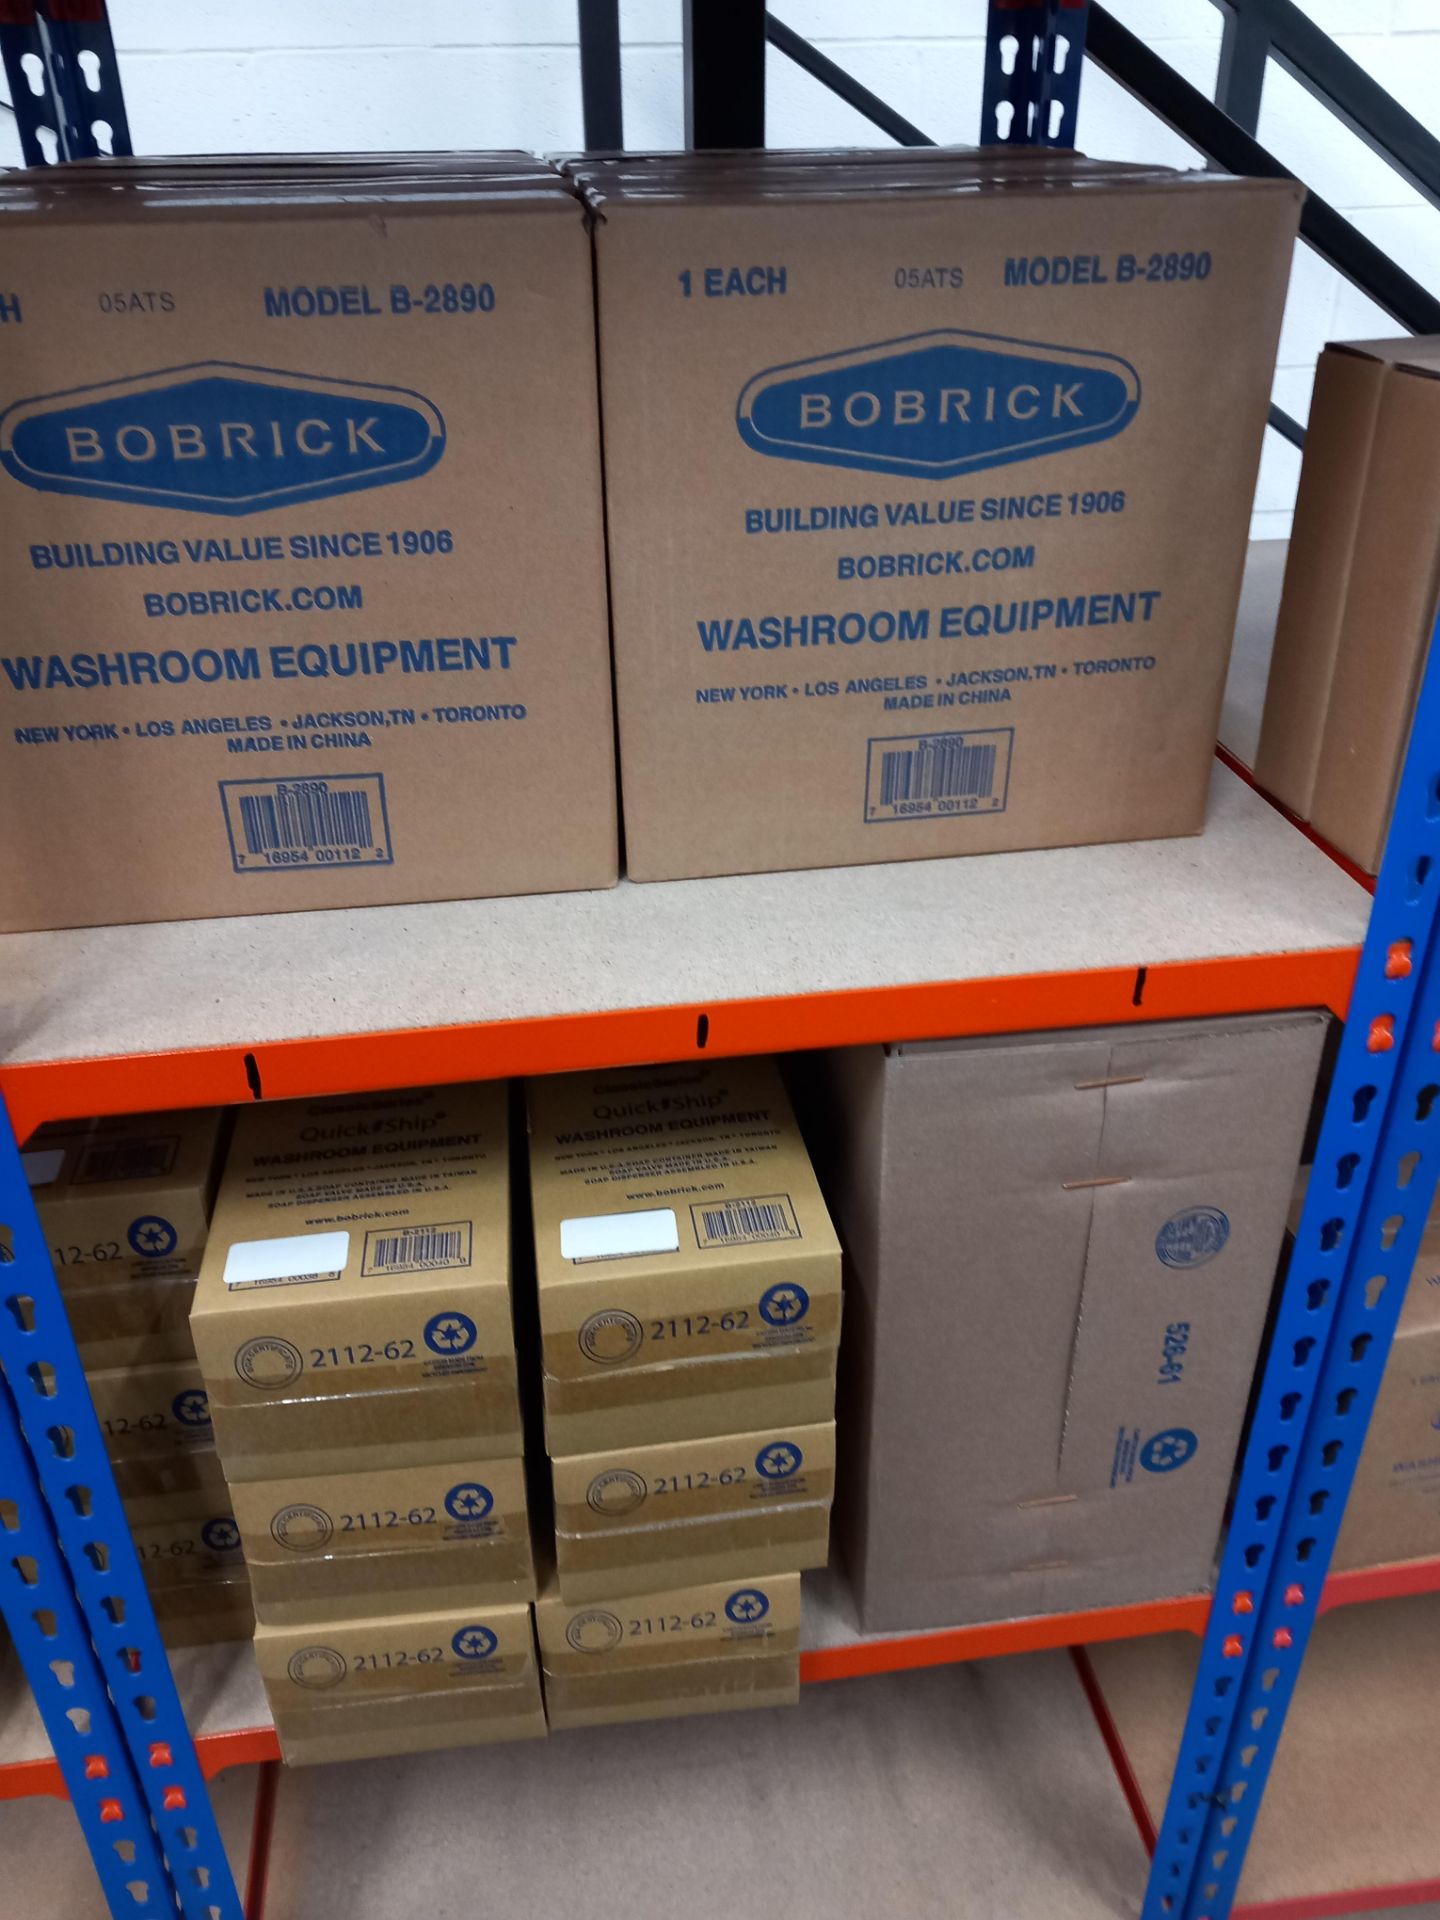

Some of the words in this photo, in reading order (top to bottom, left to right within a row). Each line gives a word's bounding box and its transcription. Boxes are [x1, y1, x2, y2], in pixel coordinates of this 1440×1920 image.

[678, 270, 691, 297] 1
[704, 266, 787, 296] EACH
[1003, 256, 1107, 287] MODEL
[1115, 252, 1211, 283] B-2890
[264, 285, 382, 318] MODEL
[390, 283, 495, 314] B-2890
[800, 382, 1084, 429] BOBRICK
[66, 417, 385, 463] BOBRICK
[745, 505, 879, 534] BUILDING
[884, 500, 974, 526] VALUE
[980, 494, 1062, 521] SINCE
[1066, 491, 1126, 515] 1906
[29, 540, 180, 570] BUILDING
[186, 535, 284, 563] VALUE
[290, 532, 381, 560] SINCE
[386, 529, 454, 555] 1906
[837, 545, 1035, 580] BOBRICK.COM
[143, 585, 363, 617] BOBRICK.COM
[697, 609, 929, 651] WASHROOM
[939, 591, 1161, 639] EQUIPMENT
[1, 646, 260, 691] WASHROOM
[271, 636, 517, 678] EQUIPMENT
[695, 688, 735, 705] NEW
[739, 684, 788, 702] YORK
[805, 681, 839, 698] LOS
[845, 675, 928, 695] ANGELES
[1073, 656, 1156, 676] TORONTO
[883, 694, 933, 711] MADE
[937, 692, 955, 707] IN
[958, 688, 1012, 706] CHINA
[15, 727, 59, 744] NEW
[62, 723, 118, 743] YORK
[136, 720, 174, 737] LOS
[182, 715, 272, 736] ANGELES
[433, 704, 527, 724] TORONTO
[228, 735, 284, 754] MADE
[288, 734, 307, 750] IN
[310, 732, 372, 749] CHINA
[264, 851, 309, 864] 16954
[316, 848, 361, 861] 00112
[556, 1122, 663, 1145] WASHROOM
[668, 1110, 770, 1130] EQUIPMENT
[253, 1146, 367, 1167] WASHROOM
[372, 1134, 482, 1154] EQUIPMENT
[626, 1182, 725, 1201] www.bobrick.com
[305, 1208, 410, 1225] www.bobrick.com
[56, 1242, 123, 1265] 12-62
[651, 1311, 749, 1340] 2112-62
[310, 1340, 416, 1369] 2112-62
[104, 1414, 168, 1437] 12-62
[653, 1467, 747, 1495] 2112-62
[340, 1507, 437, 1532] 2112-62
[138, 1540, 195, 1560] 12-62
[629, 1611, 716, 1637] 2112-62
[353, 1647, 444, 1672] 2112-62
